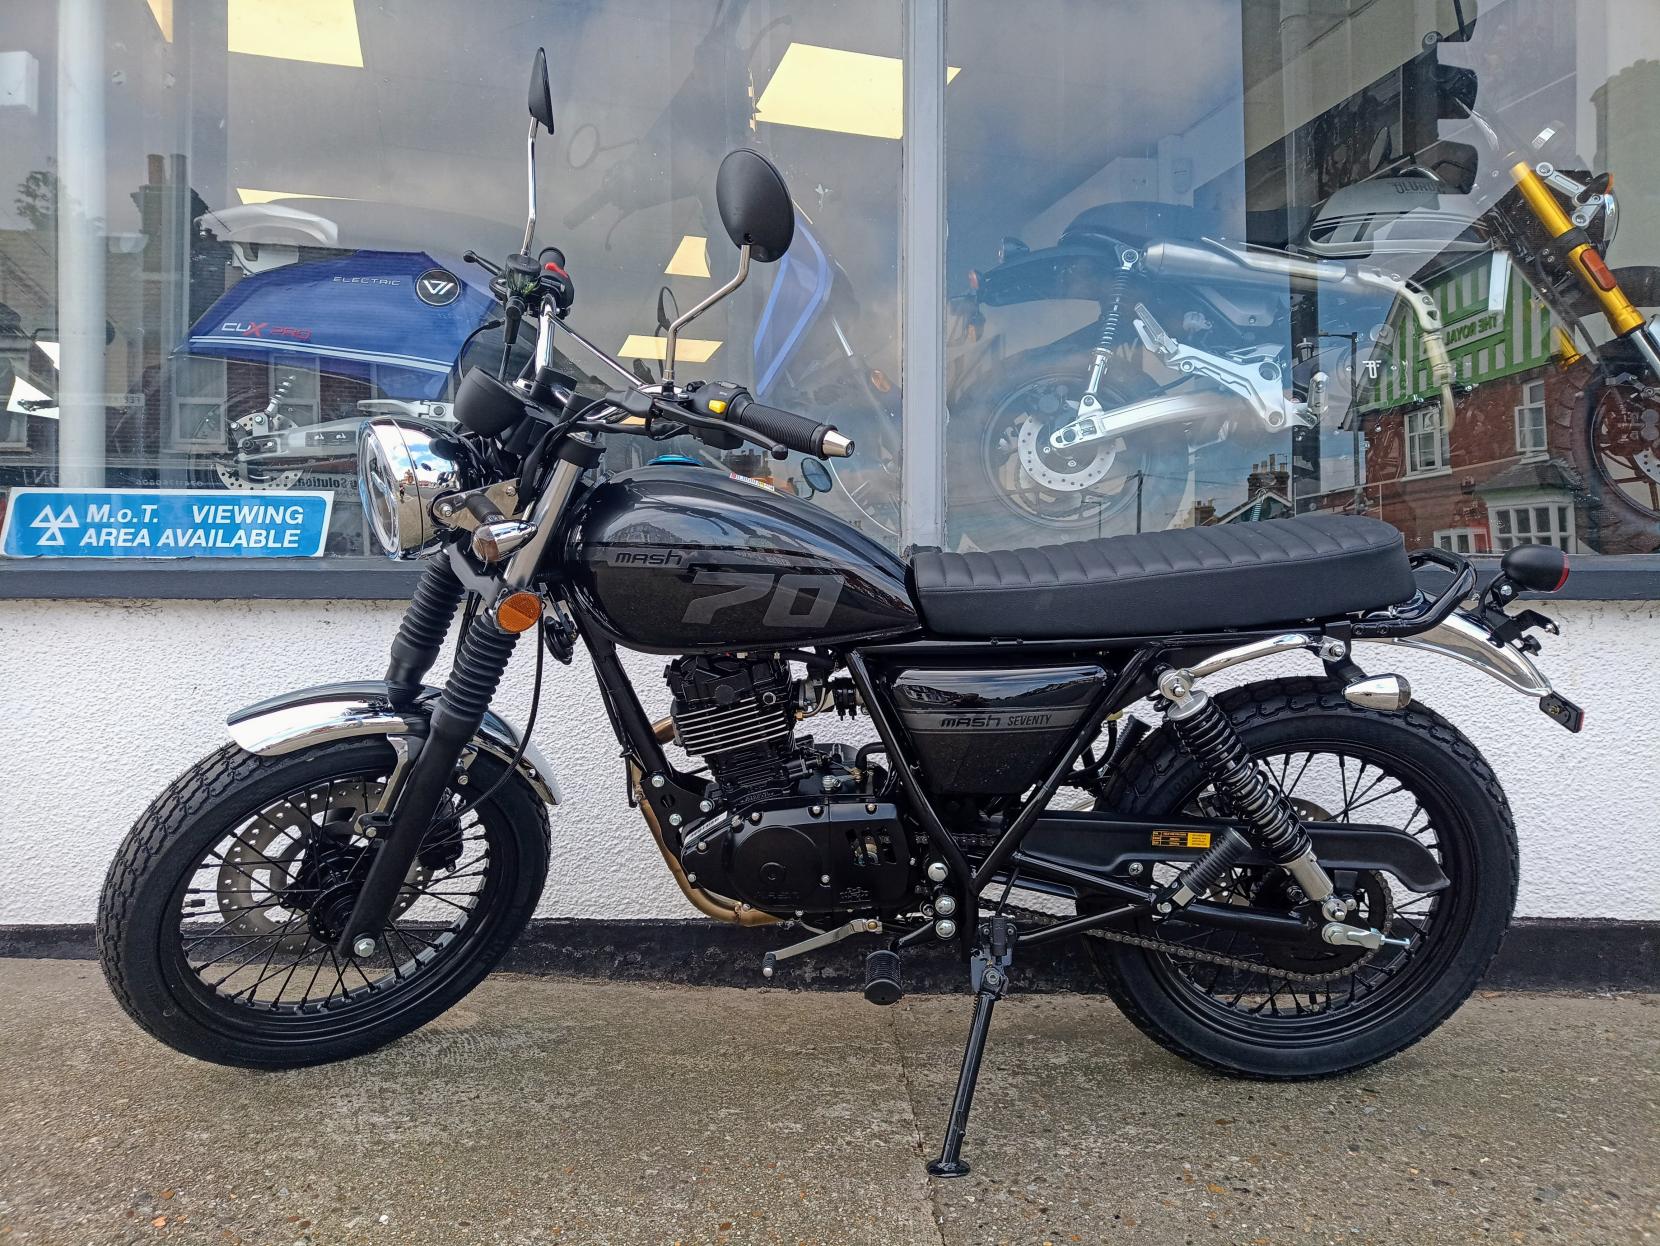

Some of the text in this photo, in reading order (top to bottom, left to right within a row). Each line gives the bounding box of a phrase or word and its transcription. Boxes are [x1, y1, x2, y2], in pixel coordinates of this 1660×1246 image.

[332, 276, 401, 286] ELECTRIC
[221, 322, 312, 341] CUX PRO
[86, 504, 304, 525] M.o.T. VIEWING
[79, 528, 301, 548] AREA AVAILABLE
[681, 571, 845, 628] 70
[1007, 714, 1052, 727] SEVENTY
